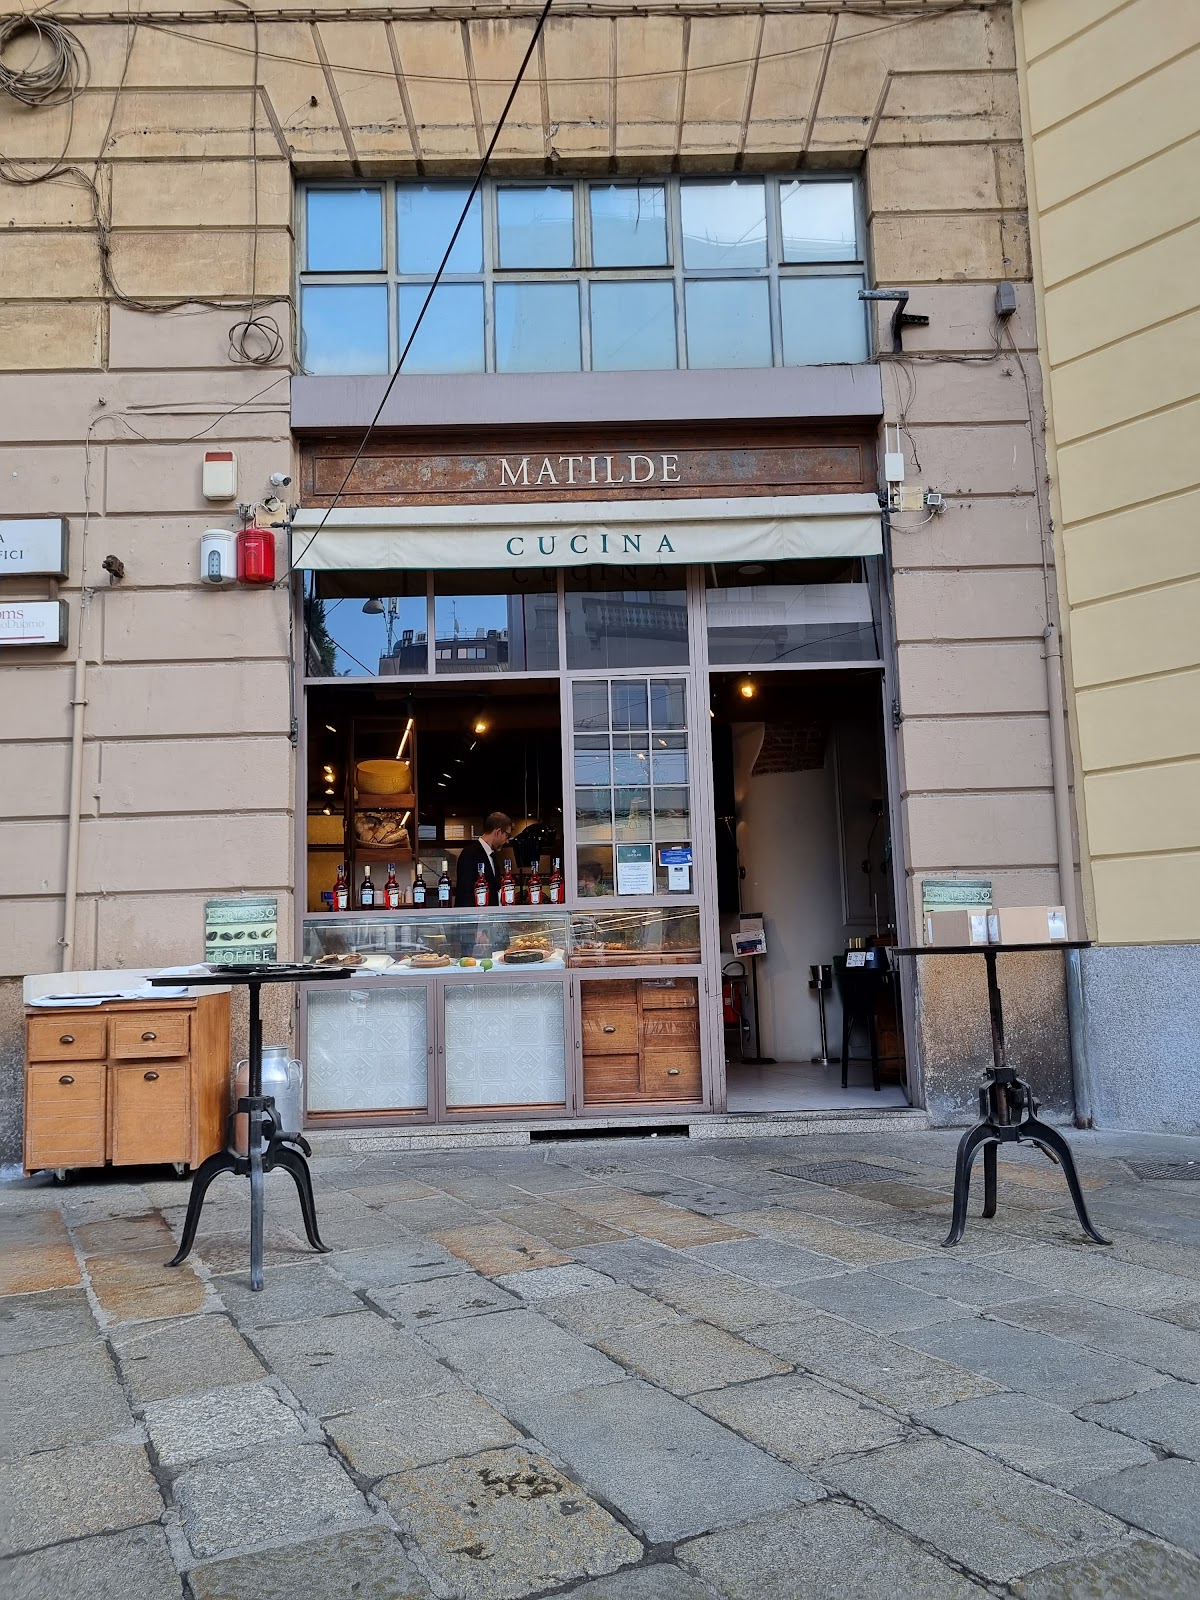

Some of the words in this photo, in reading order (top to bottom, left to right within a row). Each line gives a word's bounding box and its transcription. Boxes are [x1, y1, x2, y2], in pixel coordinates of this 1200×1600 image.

[499, 454, 681, 486] MATILDE
[506, 534, 675, 556] CUCINA
[213, 950, 270, 963] COFFEE
